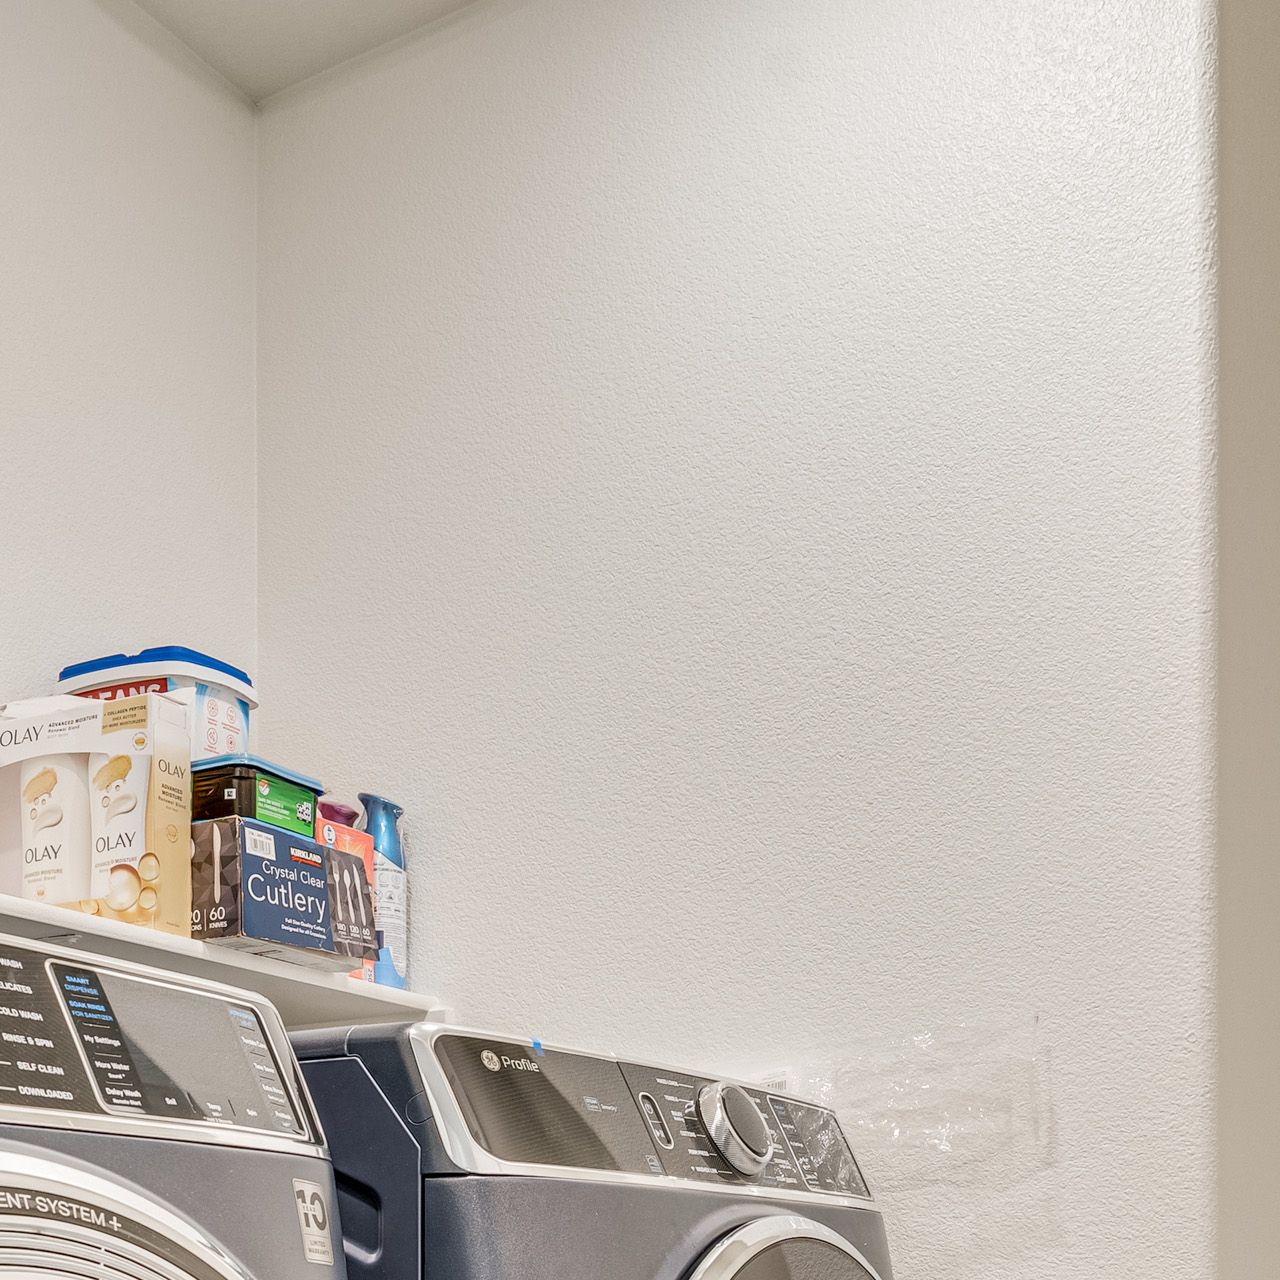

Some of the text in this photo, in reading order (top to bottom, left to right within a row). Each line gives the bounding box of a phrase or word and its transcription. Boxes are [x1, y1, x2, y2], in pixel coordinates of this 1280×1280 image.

[0, 725, 44, 747] OLAY
[157, 758, 187, 780] OLAY
[95, 831, 136, 853] OLAY
[24, 844, 62, 864] OLAY
[290, 847, 322, 863] KIRKLAND
[262, 860, 298, 881] Crystal
[300, 871, 325, 889] Clear
[247, 873, 326, 923] Cutlery
[209, 906, 226, 920] 60
[19, 1009, 44, 1022] WASH
[2, 1032, 55, 1049] RINSE & SPIN
[16, 1061, 65, 1076] SELF CLEAN
[501, 1055, 540, 1073] Profile
[18, 1085, 74, 1101] DOWNLOADED
[35, 1197, 106, 1227] SYSTEM
[109, 1216, 122, 1231] +
[296, 1190, 327, 1231] 10
